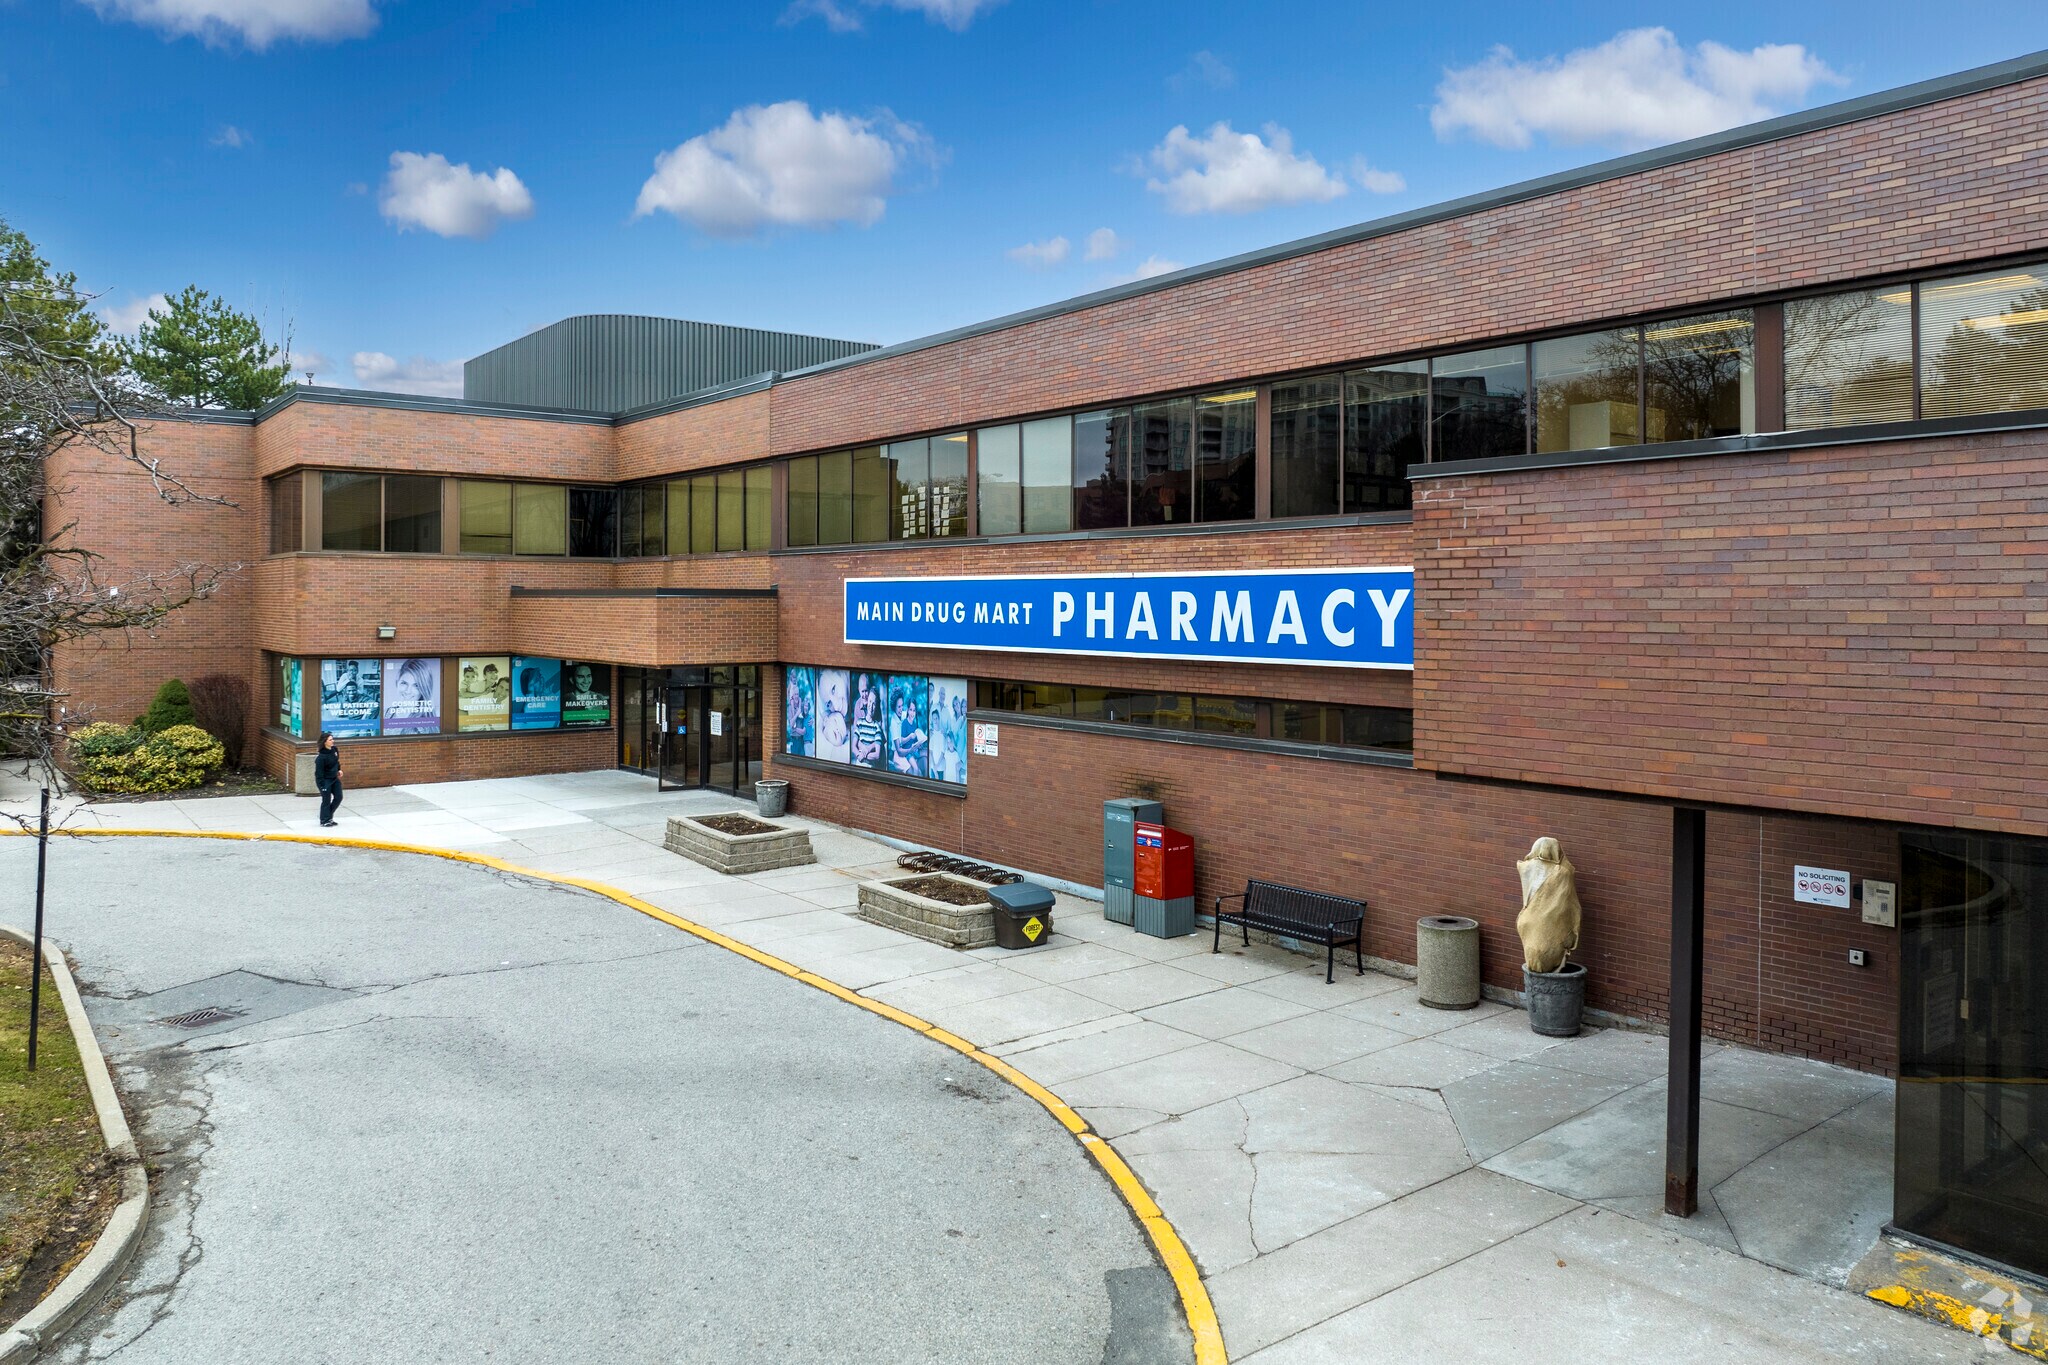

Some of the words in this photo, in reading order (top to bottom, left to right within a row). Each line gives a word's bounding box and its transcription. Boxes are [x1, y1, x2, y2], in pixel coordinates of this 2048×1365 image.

[857, 602, 904, 621] MAIN
[911, 602, 966, 624] DRUG
[973, 603, 1033, 625] MART
[1052, 588, 1411, 648] PHARMACY
[515, 695, 560, 703] EMERGENCY
[330, 708, 372, 716] WELCOME
[390, 706, 434, 714] DENTISTRY
[1809, 872, 1846, 883] SOLICITING
